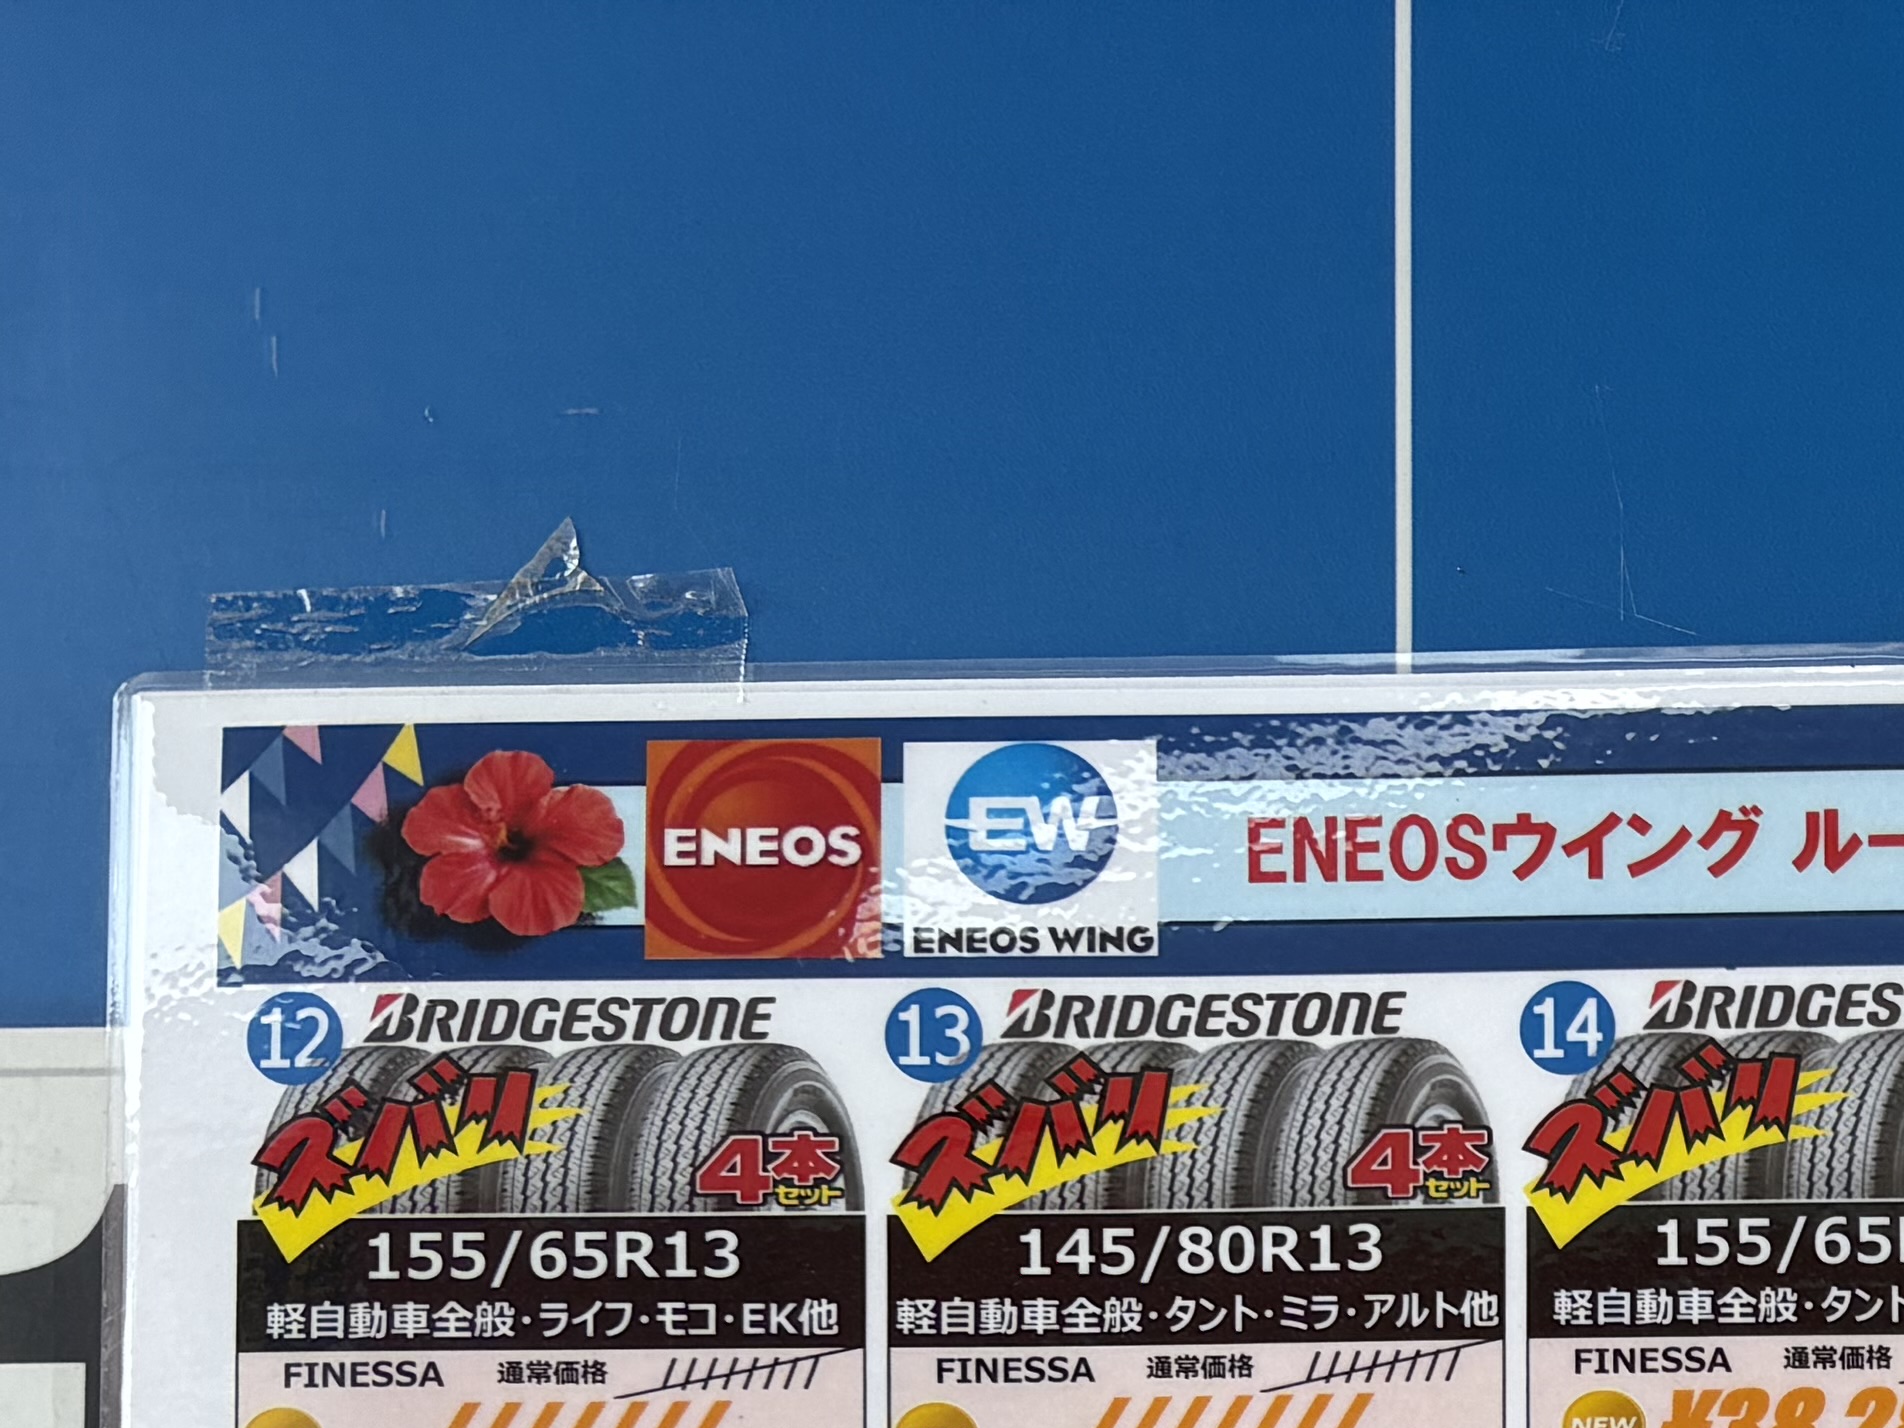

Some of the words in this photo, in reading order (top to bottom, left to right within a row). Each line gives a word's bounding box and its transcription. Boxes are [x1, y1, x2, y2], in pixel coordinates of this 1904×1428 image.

[663, 825, 863, 868] ENEOS
[969, 797, 1101, 852] EW
[1247, 803, 1764, 886] ENEOSウイング
[914, 927, 1040, 954] ENEOS
[1048, 926, 1155, 953] WING
[260, 1007, 328, 1068] 12
[363, 995, 775, 1042] BRIDGESTONE
[1533, 998, 1603, 1058] 14
[251, 1054, 538, 1212] ズバリ
[695, 1131, 847, 1205] 4本
[773, 1184, 843, 1207] セット
[369, 1230, 739, 1287] 155/65R13
[1020, 1223, 1382, 1283] 145/80R13
[285, 1361, 444, 1388] FINESSA
[497, 1360, 608, 1385] 通常価格
[1575, 1346, 1732, 1374] FINESSA
